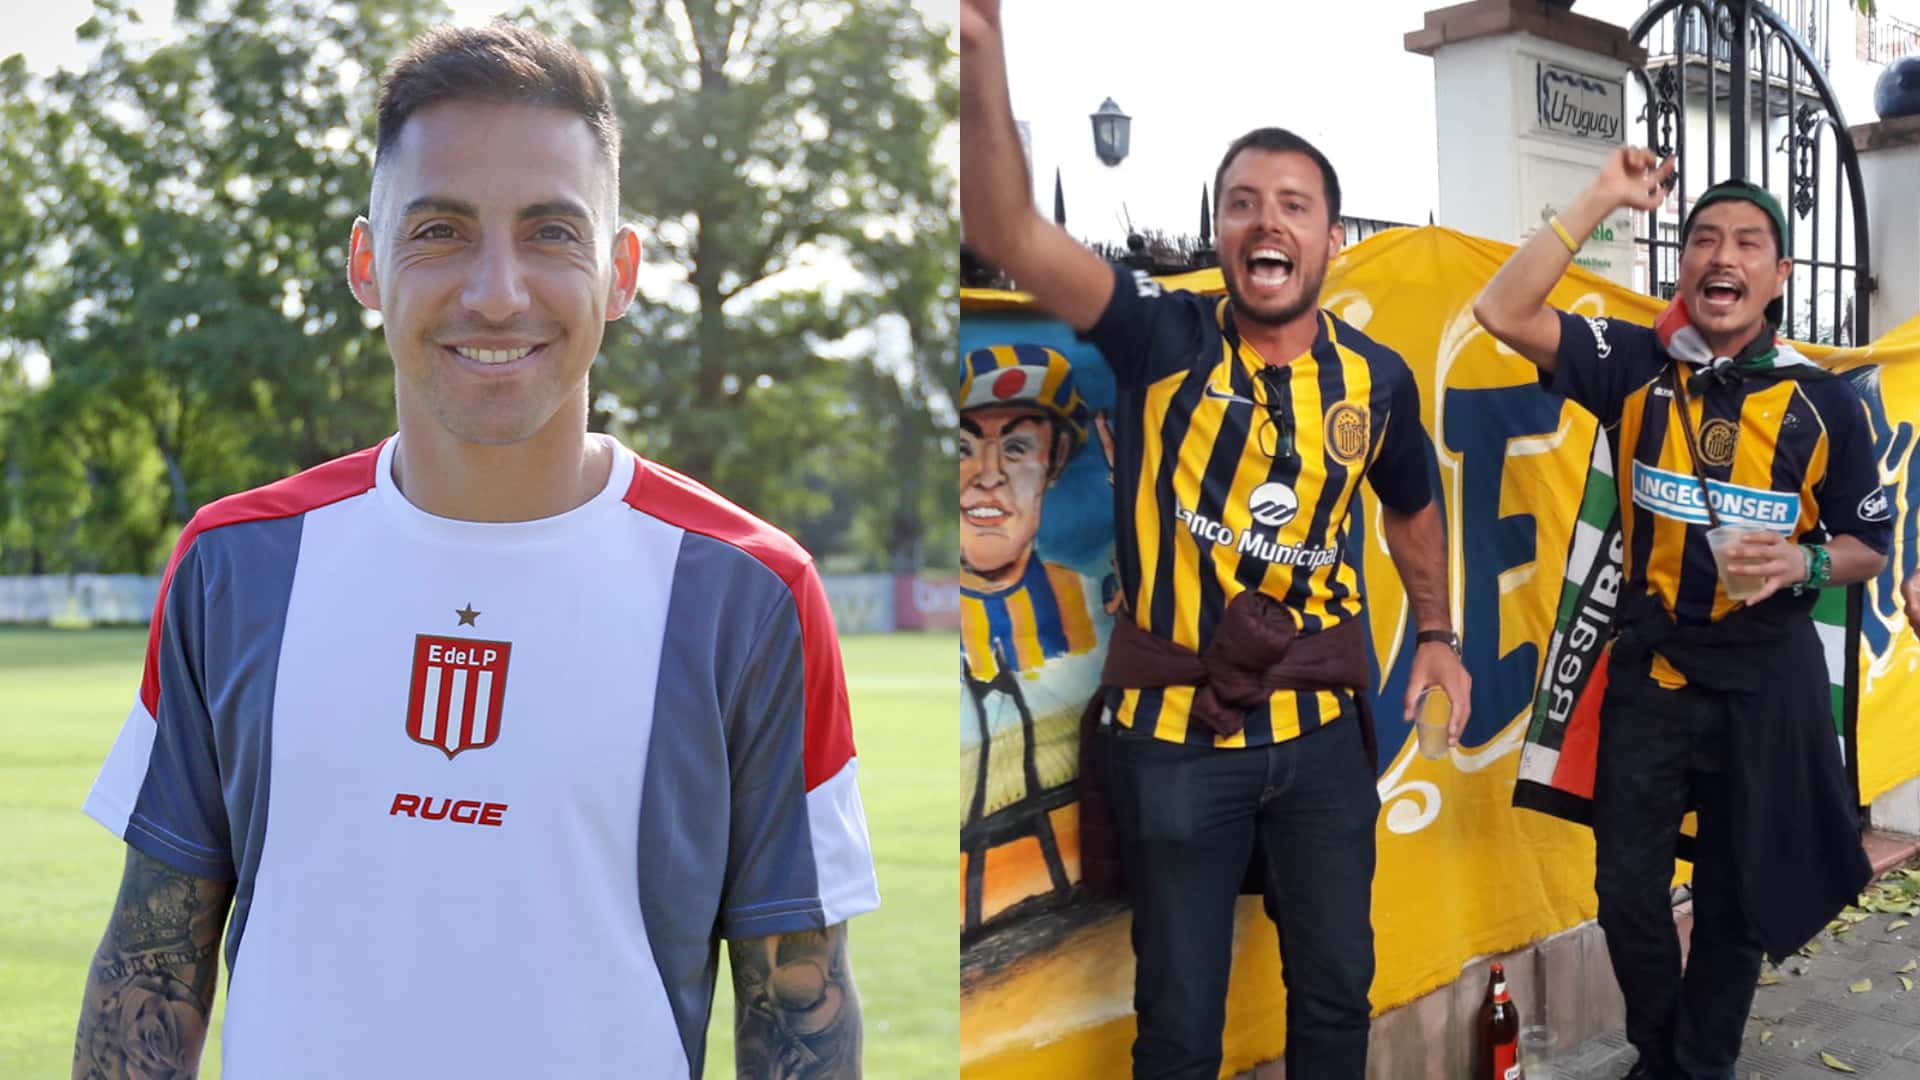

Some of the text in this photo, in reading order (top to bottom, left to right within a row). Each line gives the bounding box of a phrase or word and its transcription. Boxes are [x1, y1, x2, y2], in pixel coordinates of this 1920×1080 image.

[1551, 90, 1618, 138] Uruguay
[1640, 473, 1789, 522] INGECONSER
[1237, 529, 1338, 572] Municipal
[390, 793, 508, 826] RUGE
